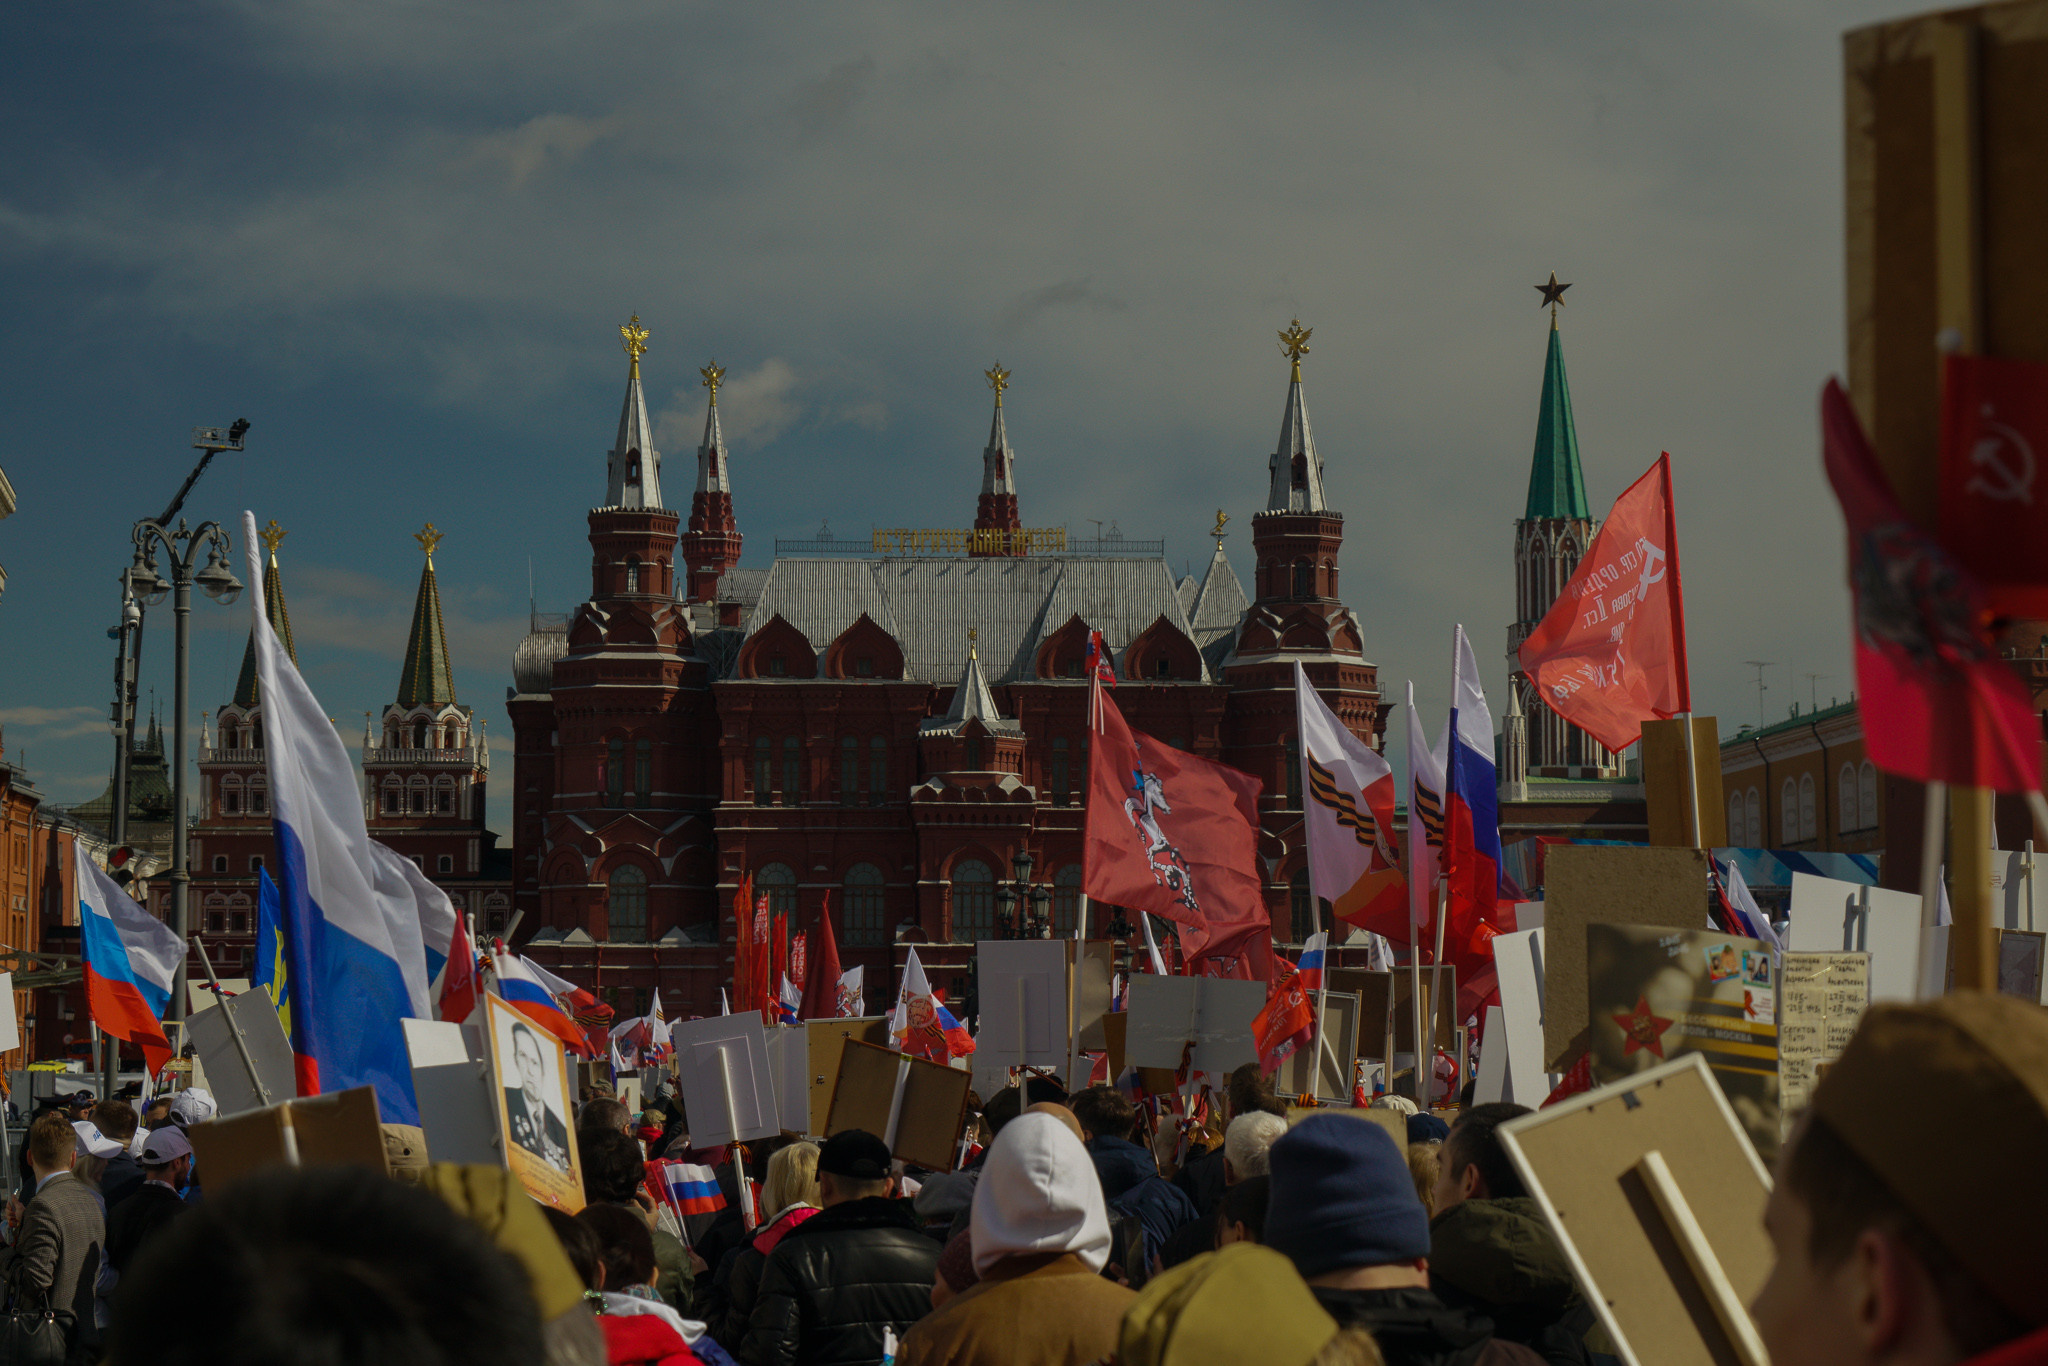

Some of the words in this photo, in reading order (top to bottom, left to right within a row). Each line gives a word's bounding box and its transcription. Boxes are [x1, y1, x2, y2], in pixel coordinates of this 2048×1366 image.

[872, 527, 1003, 553] ИСТОРИЧЕСКИЙ
[1010, 526, 1066, 553] МУЗЕЙ
[1714, 1028, 1753, 1042] МОСКВА
